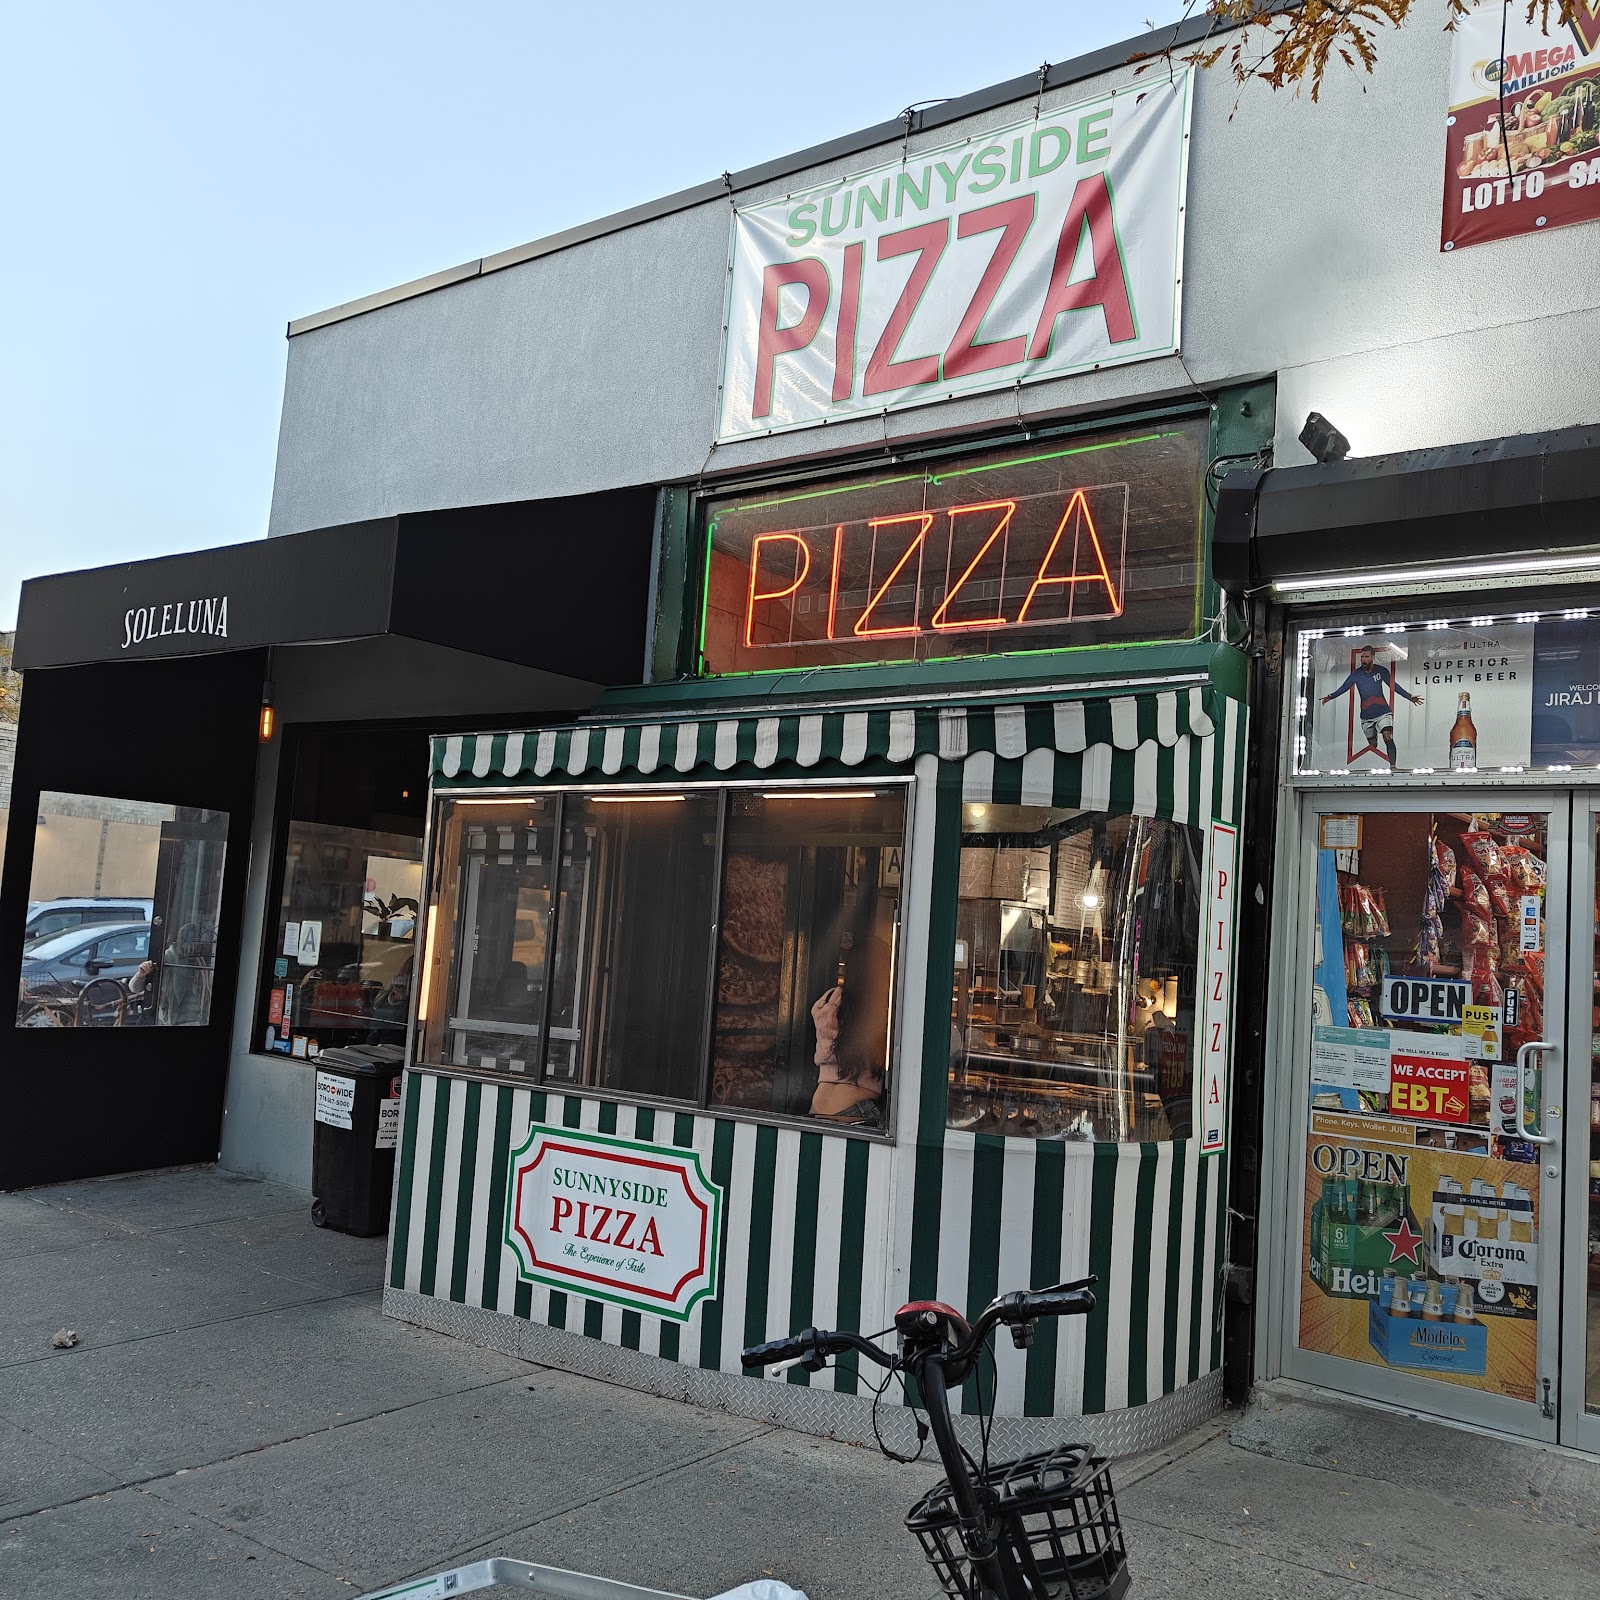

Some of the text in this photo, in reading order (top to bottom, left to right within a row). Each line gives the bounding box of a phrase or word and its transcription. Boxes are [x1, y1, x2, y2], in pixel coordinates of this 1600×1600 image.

[1503, 44, 1576, 81] MEGA
[1499, 61, 1575, 97] MILLIONS
[786, 109, 1114, 248] SUNNYSIDE
[1462, 171, 1544, 213] LOTTO
[752, 170, 1138, 420] PIZZA
[744, 489, 1122, 649] PIZZA
[121, 596, 228, 649] SOLELUNA
[1470, 640, 1500, 649] ULTRA
[1372, 672, 1382, 682] 10
[1423, 657, 1509, 671] SUPERIOR
[1415, 671, 1517, 685] LIGHT BEER
[1545, 691, 1593, 707] JIRAJ
[887, 848, 900, 873] A
[302, 926, 316, 953] A
[1208, 870, 1227, 1104] PIZZA
[1390, 980, 1467, 1018] OPEN
[1465, 1010, 1499, 1022] PUSH
[1506, 990, 1516, 1024] PUSH
[1393, 1064, 1413, 1076] WE
[1415, 1066, 1467, 1082] ACCEPT
[336, 1087, 354, 1098] WIDE
[1392, 1081, 1450, 1115] EBT
[381, 1109, 399, 1118] BOR
[1316, 1115, 1339, 1126] Phone.
[1341, 1119, 1360, 1129] Keys.
[1362, 1121, 1387, 1132] Wallet.
[1389, 1124, 1412, 1135] JUUL.
[1312, 1144, 1409, 1187] OPEN
[553, 1167, 668, 1208] SUNNYSIDE
[550, 1196, 664, 1257] PIZZA
[1335, 1228, 1343, 1239] 6
[1445, 1237, 1450, 1246] 6
[1458, 1240, 1526, 1261] Corona
[562, 1242, 646, 1274] The Experience of Taste
[1480, 1258, 1504, 1269] Extra
[1417, 1326, 1460, 1346] Modelo
